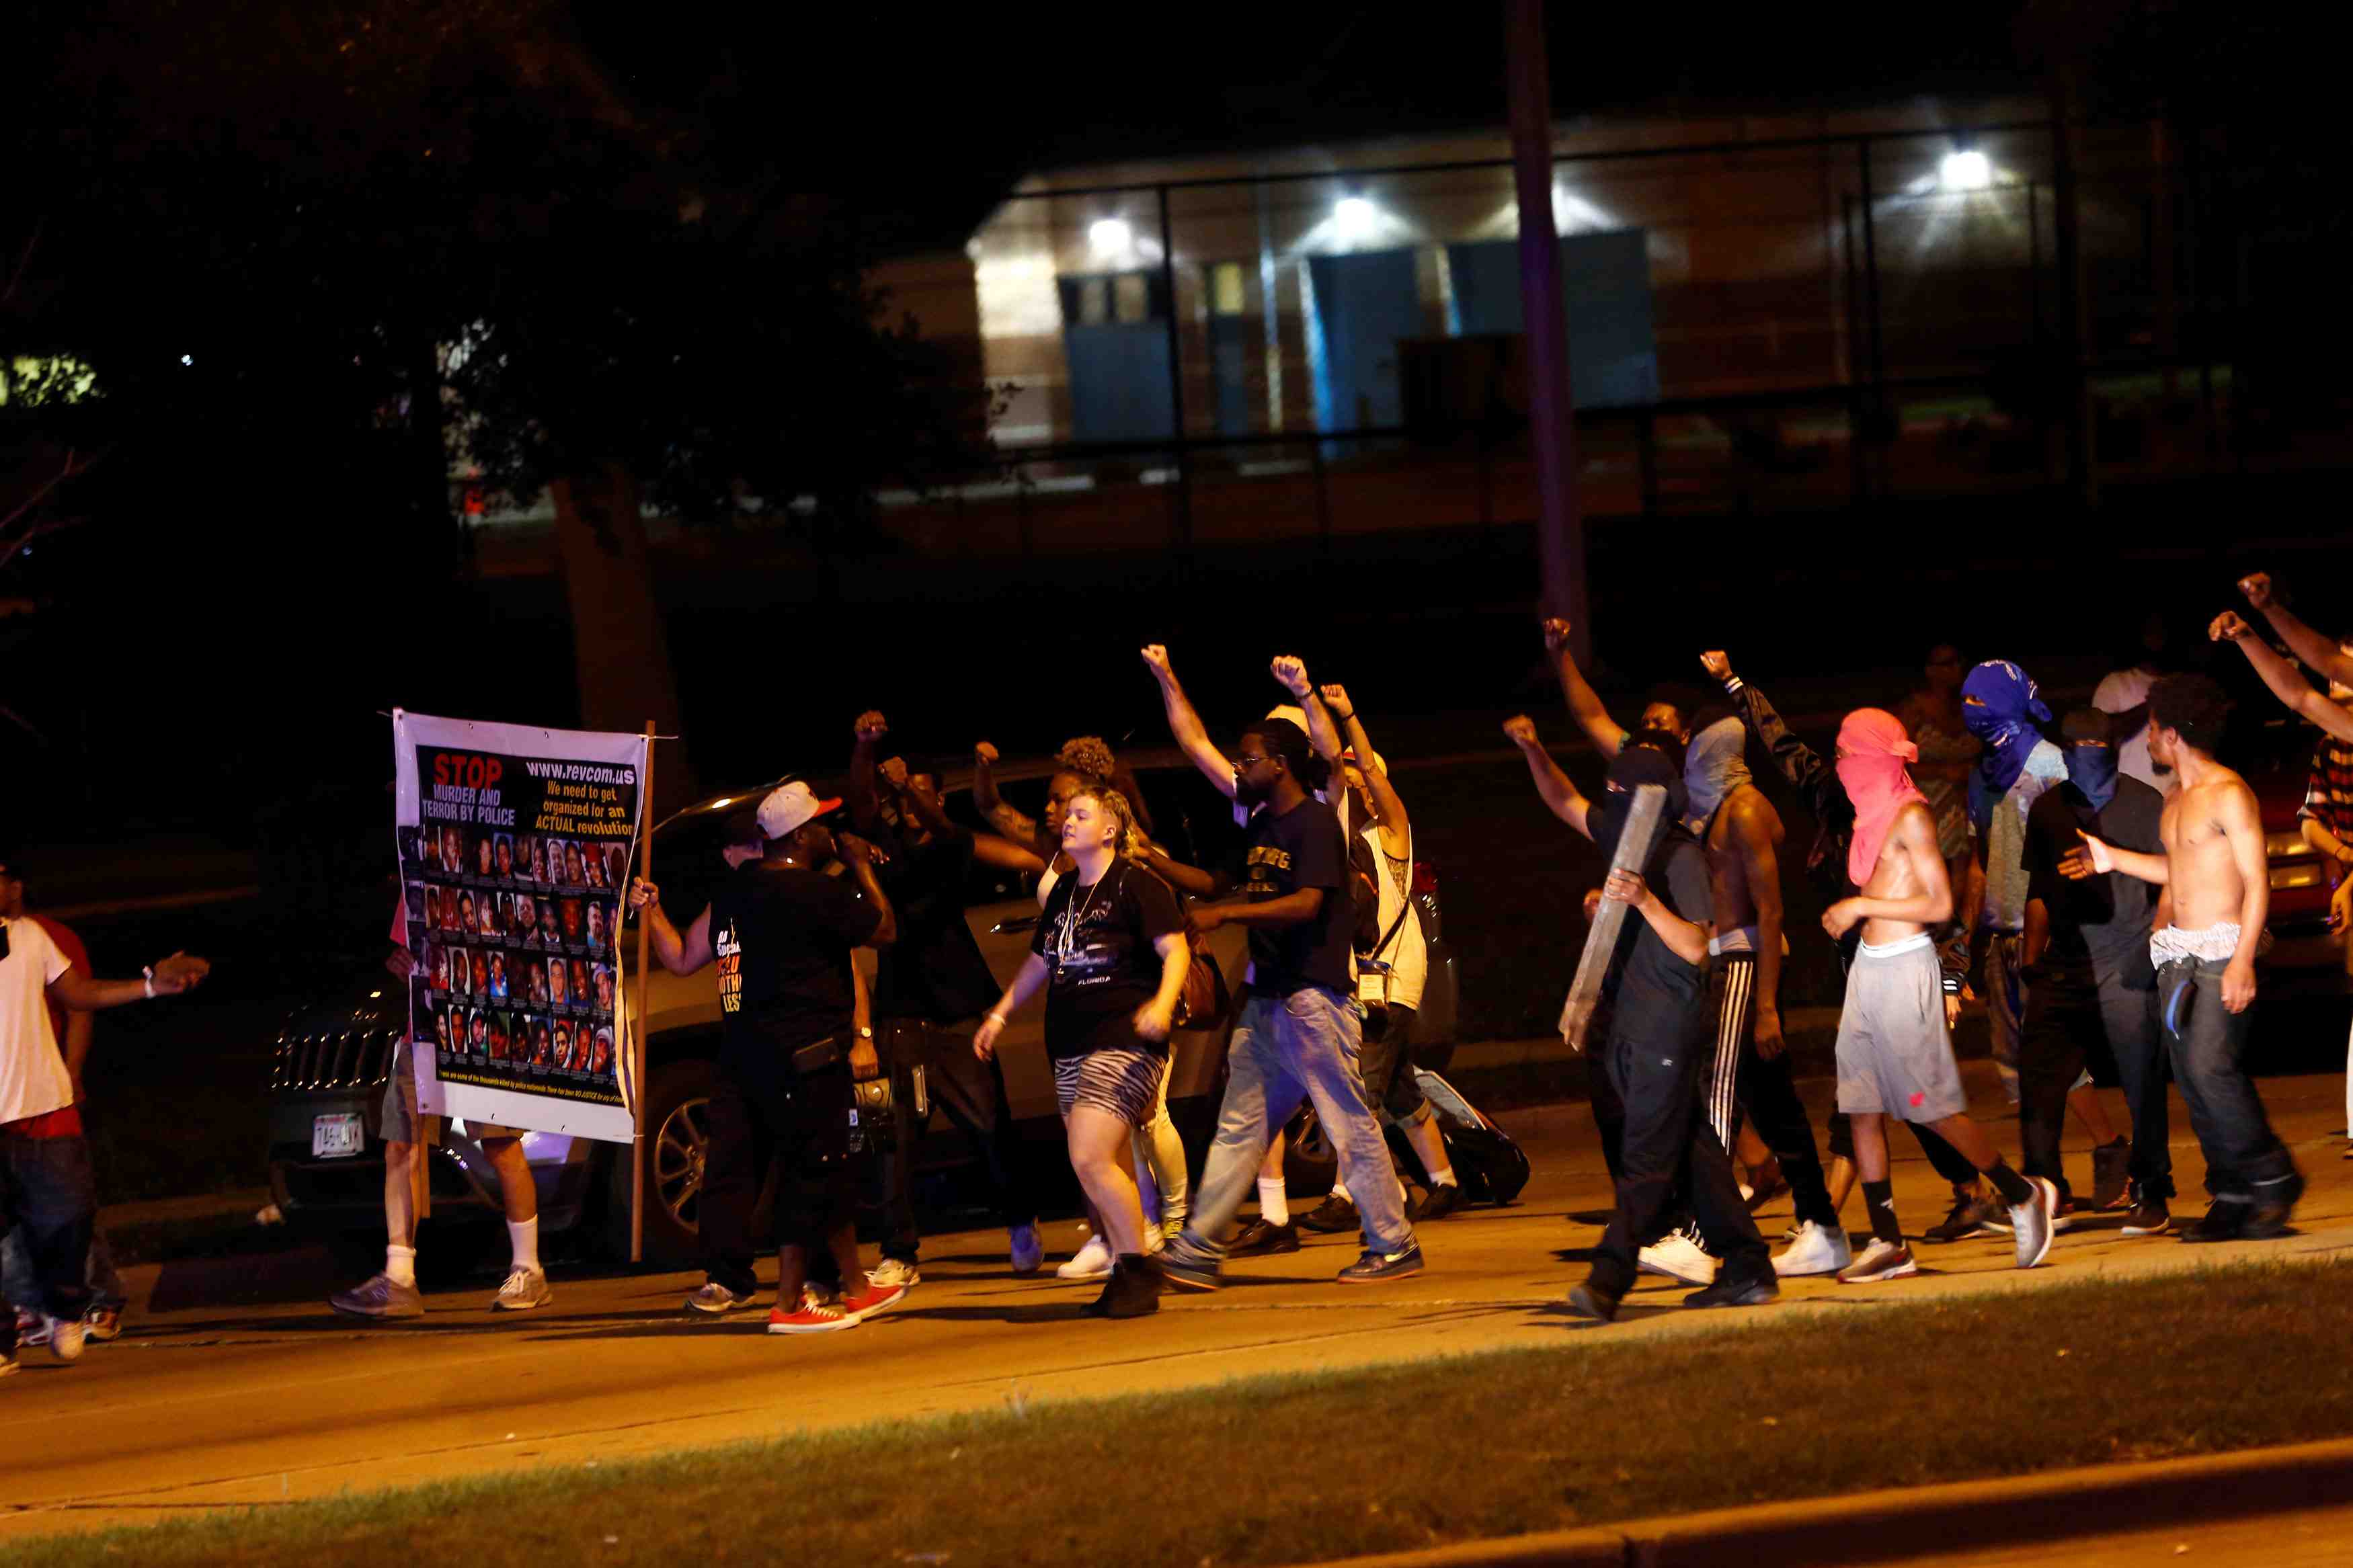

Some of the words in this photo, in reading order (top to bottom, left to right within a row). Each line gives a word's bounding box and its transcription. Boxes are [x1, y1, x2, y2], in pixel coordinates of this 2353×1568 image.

[434, 753, 503, 789] STOP
[526, 761, 635, 785] www.revcom.us
[434, 785, 476, 804] MURDER
[479, 788, 501, 806] AND
[548, 780, 561, 795] We
[563, 783, 587, 798] need
[589, 784, 598, 800] to
[601, 788, 617, 802] get
[422, 800, 457, 821] TERROR
[461, 804, 475, 822] BY
[478, 806, 516, 826] POLICE
[543, 799, 590, 817] organized
[591, 802, 604, 817] for
[608, 807, 626, 818] an
[536, 815, 575, 833] ACTUAL
